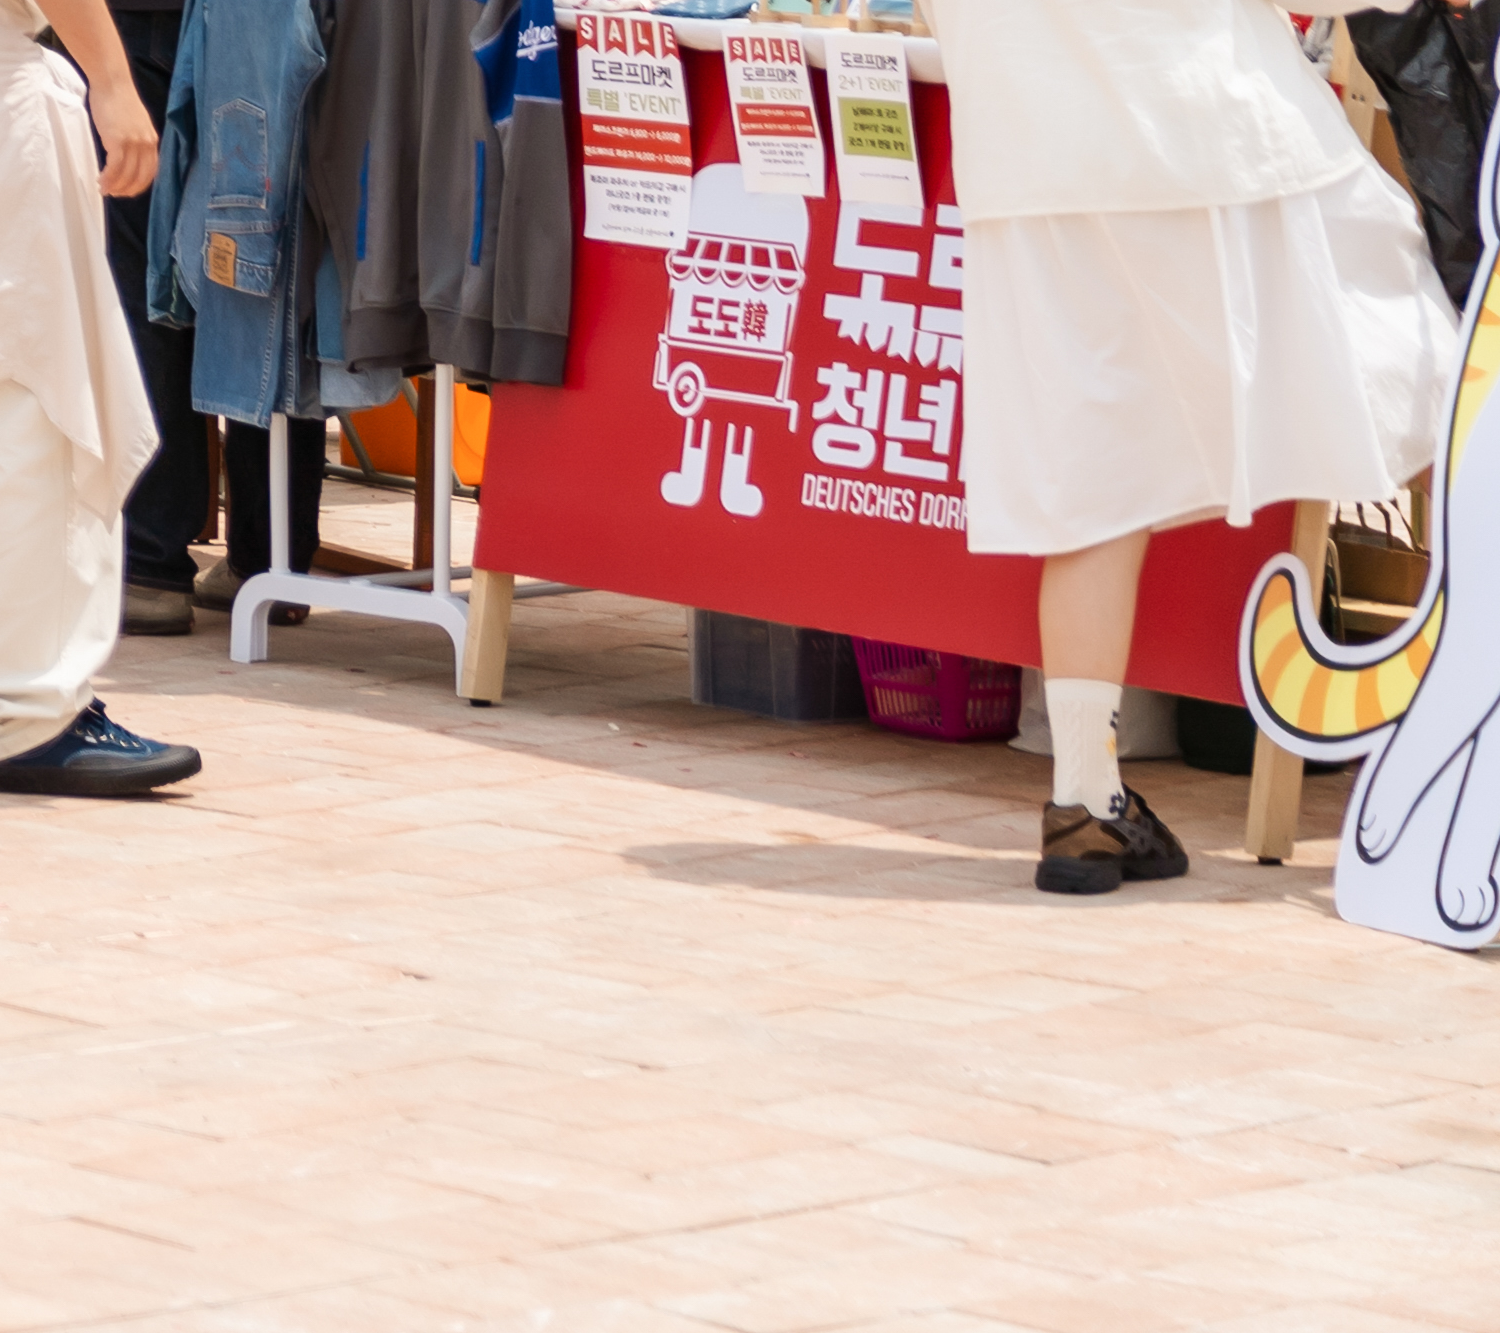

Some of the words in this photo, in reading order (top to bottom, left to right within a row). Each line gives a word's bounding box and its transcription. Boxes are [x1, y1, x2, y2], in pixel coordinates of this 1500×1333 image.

[580, 17, 676, 49] SALE
[731, 40, 799, 58] SALE
[840, 51, 899, 72] 도르프마켓
[591, 59, 673, 89] 도르프마켓
[742, 66, 798, 83] 도르프마켓
[838, 75, 864, 91] 2+1
[586, 87, 621, 112] 특별
[811, 361, 965, 482] 청년
[801, 473, 915, 524] DEUTSCHES
